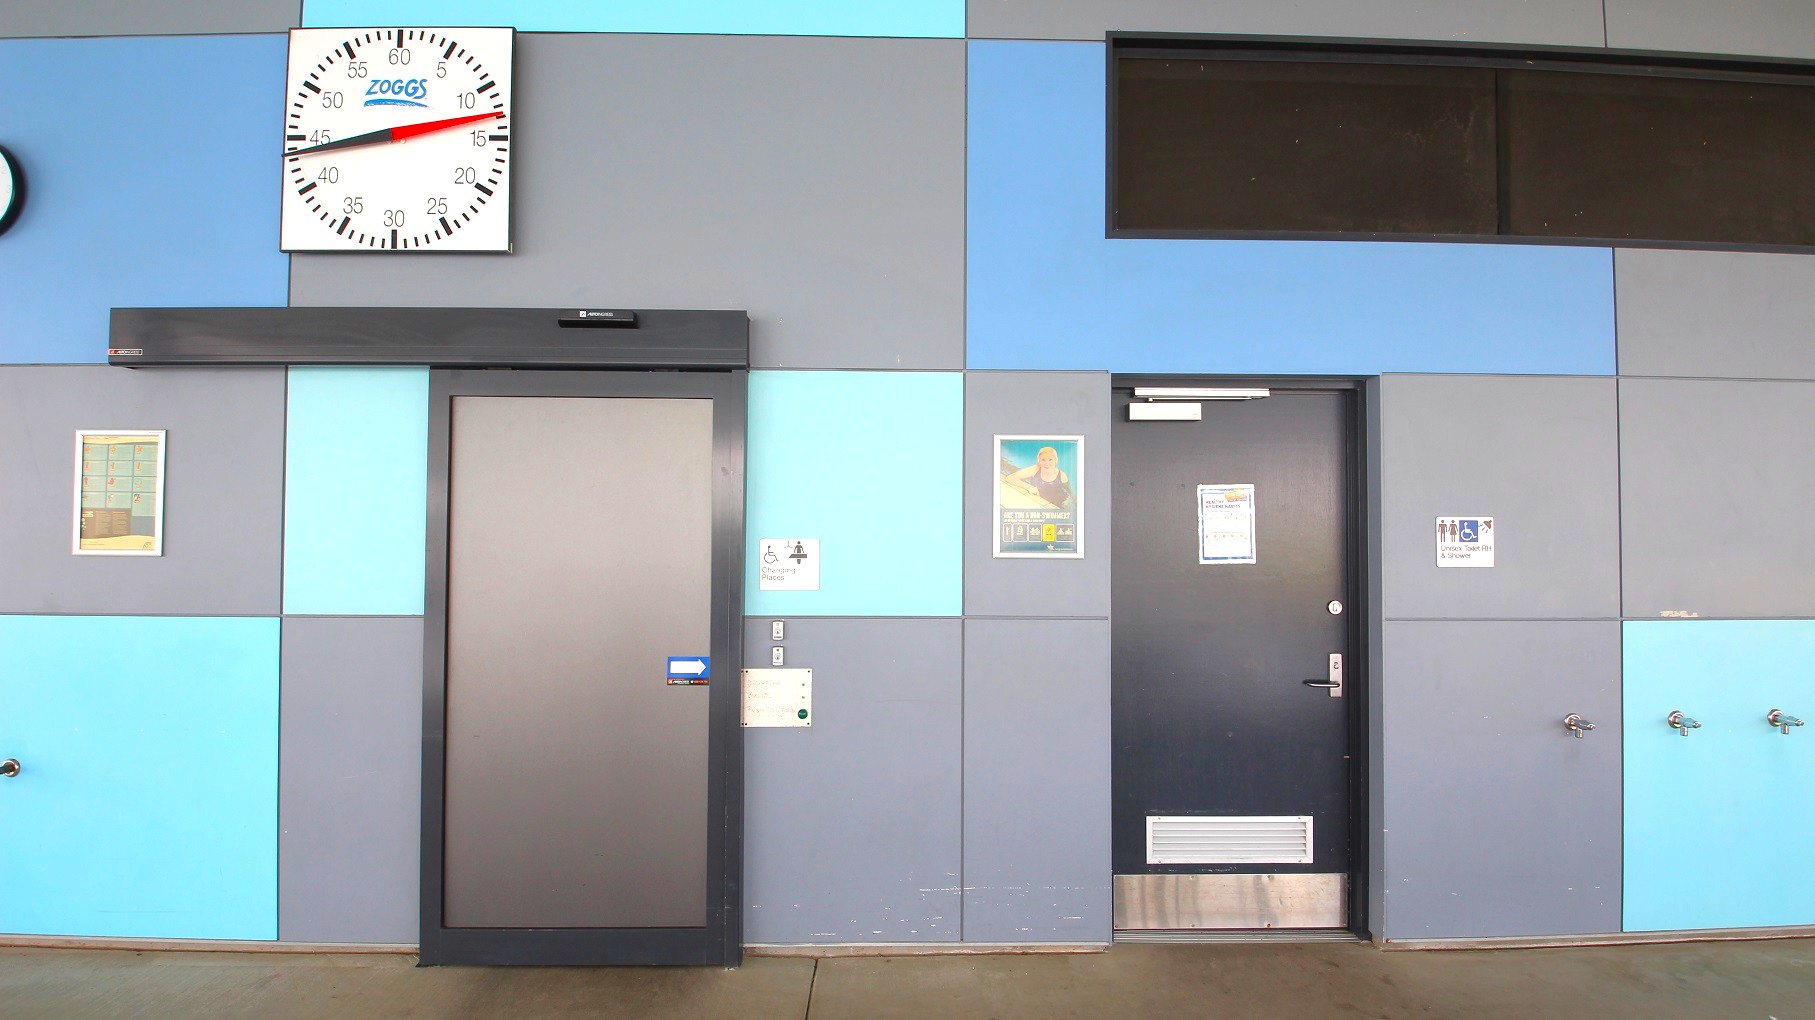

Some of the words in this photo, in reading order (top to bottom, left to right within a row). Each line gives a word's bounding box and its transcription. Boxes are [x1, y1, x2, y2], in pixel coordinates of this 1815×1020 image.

[389, 48, 411, 66] 60
[347, 61, 368, 79] 55
[436, 61, 447, 79] 5
[365, 79, 428, 99] ZOGGS
[322, 92, 344, 109] 50
[457, 92, 476, 110] 10
[309, 129, 331, 147] 45
[470, 130, 487, 147] 15
[317, 166, 339, 184] 40
[454, 167, 476, 185] 20
[343, 197, 364, 215] 35
[426, 197, 448, 215] 25
[383, 210, 405, 228] 30
[761, 566, 796, 575] Changing
